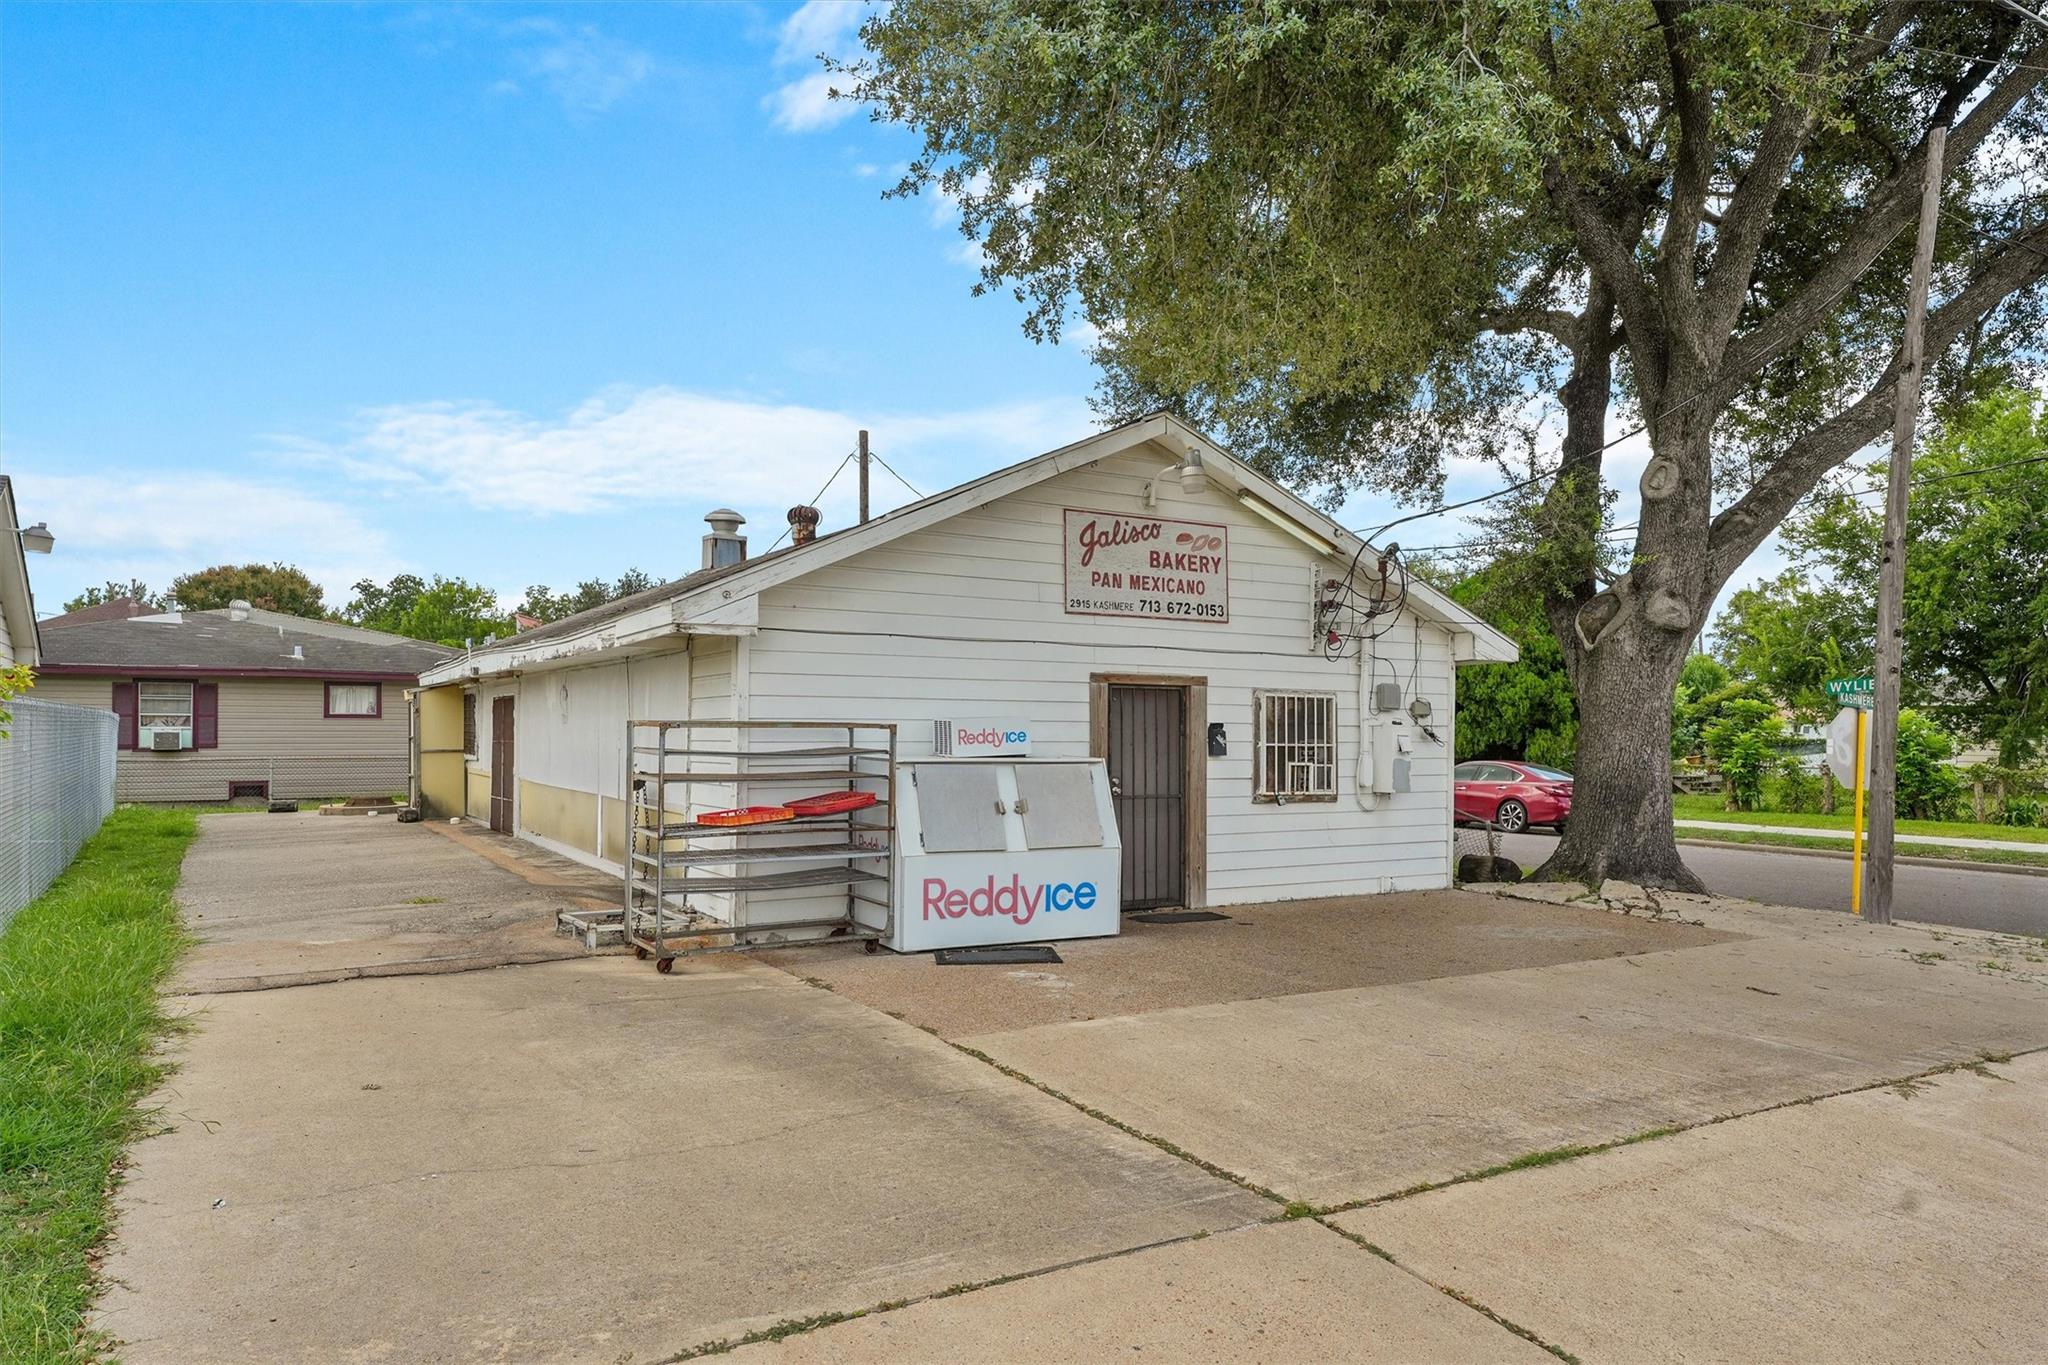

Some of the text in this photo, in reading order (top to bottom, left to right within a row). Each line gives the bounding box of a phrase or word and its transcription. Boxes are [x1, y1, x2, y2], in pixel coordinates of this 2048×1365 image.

[1079, 520, 1162, 567] Jalisco
[1150, 550, 1222, 575] BAKERY
[1091, 571, 1206, 596] PAN MEXICANO
[1070, 599, 1225, 617] 2915 KASHMERE 713 672-0153
[1830, 679, 1874, 692] WYLIE
